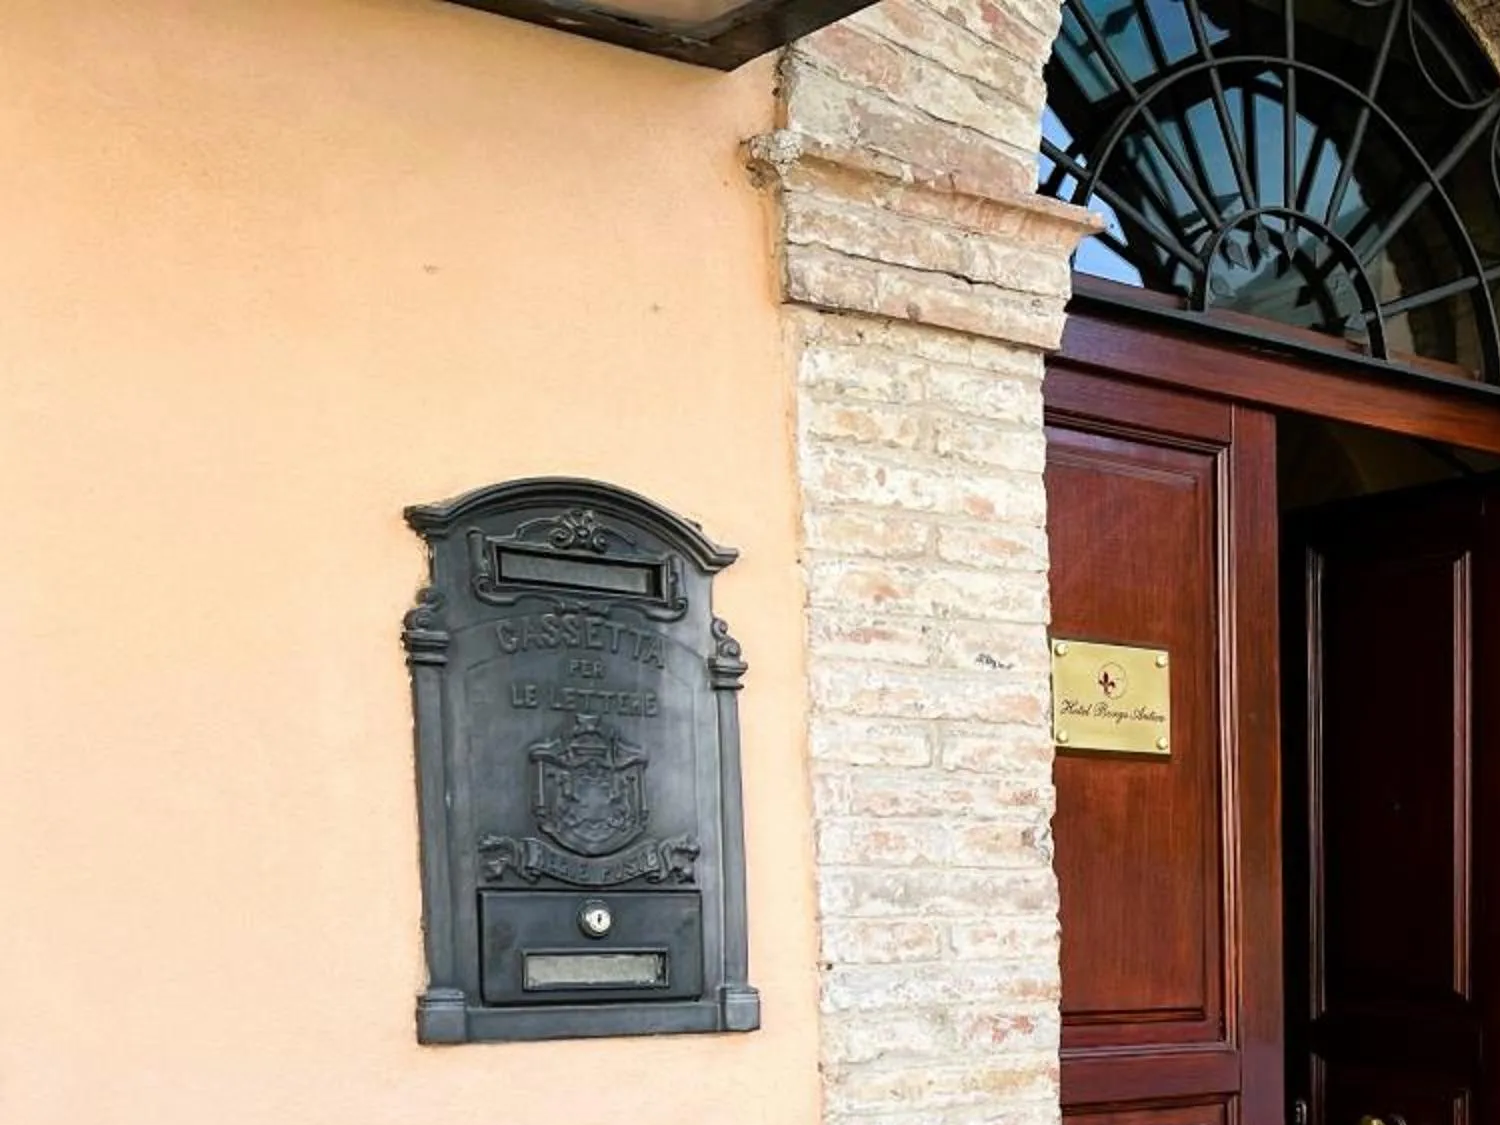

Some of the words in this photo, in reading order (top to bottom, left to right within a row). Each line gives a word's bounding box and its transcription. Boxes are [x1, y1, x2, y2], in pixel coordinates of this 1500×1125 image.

[496, 613, 667, 669] CASSETTA
[569, 658, 604, 679] PER
[511, 682, 538, 709] LE
[551, 686, 659, 718] LETTERE
